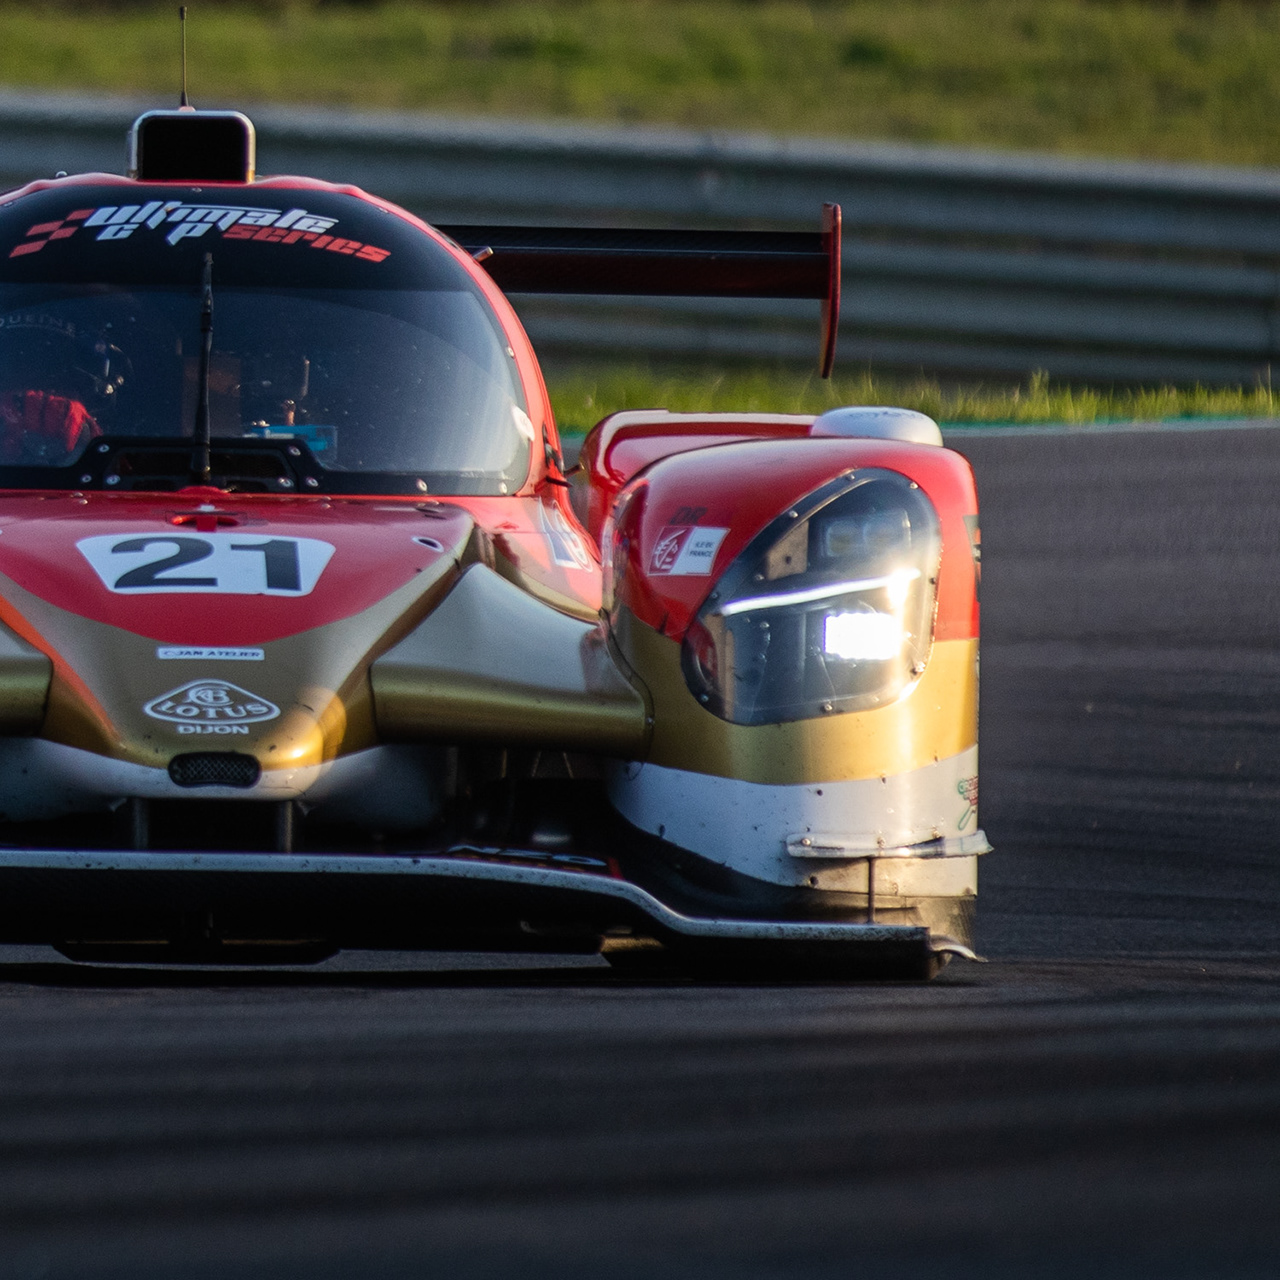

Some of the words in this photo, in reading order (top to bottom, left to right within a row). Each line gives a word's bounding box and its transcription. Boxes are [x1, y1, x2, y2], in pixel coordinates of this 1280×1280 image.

[111, 536, 302, 591] 21
[158, 701, 270, 718] LOTUS
[177, 724, 249, 734] DIJON
